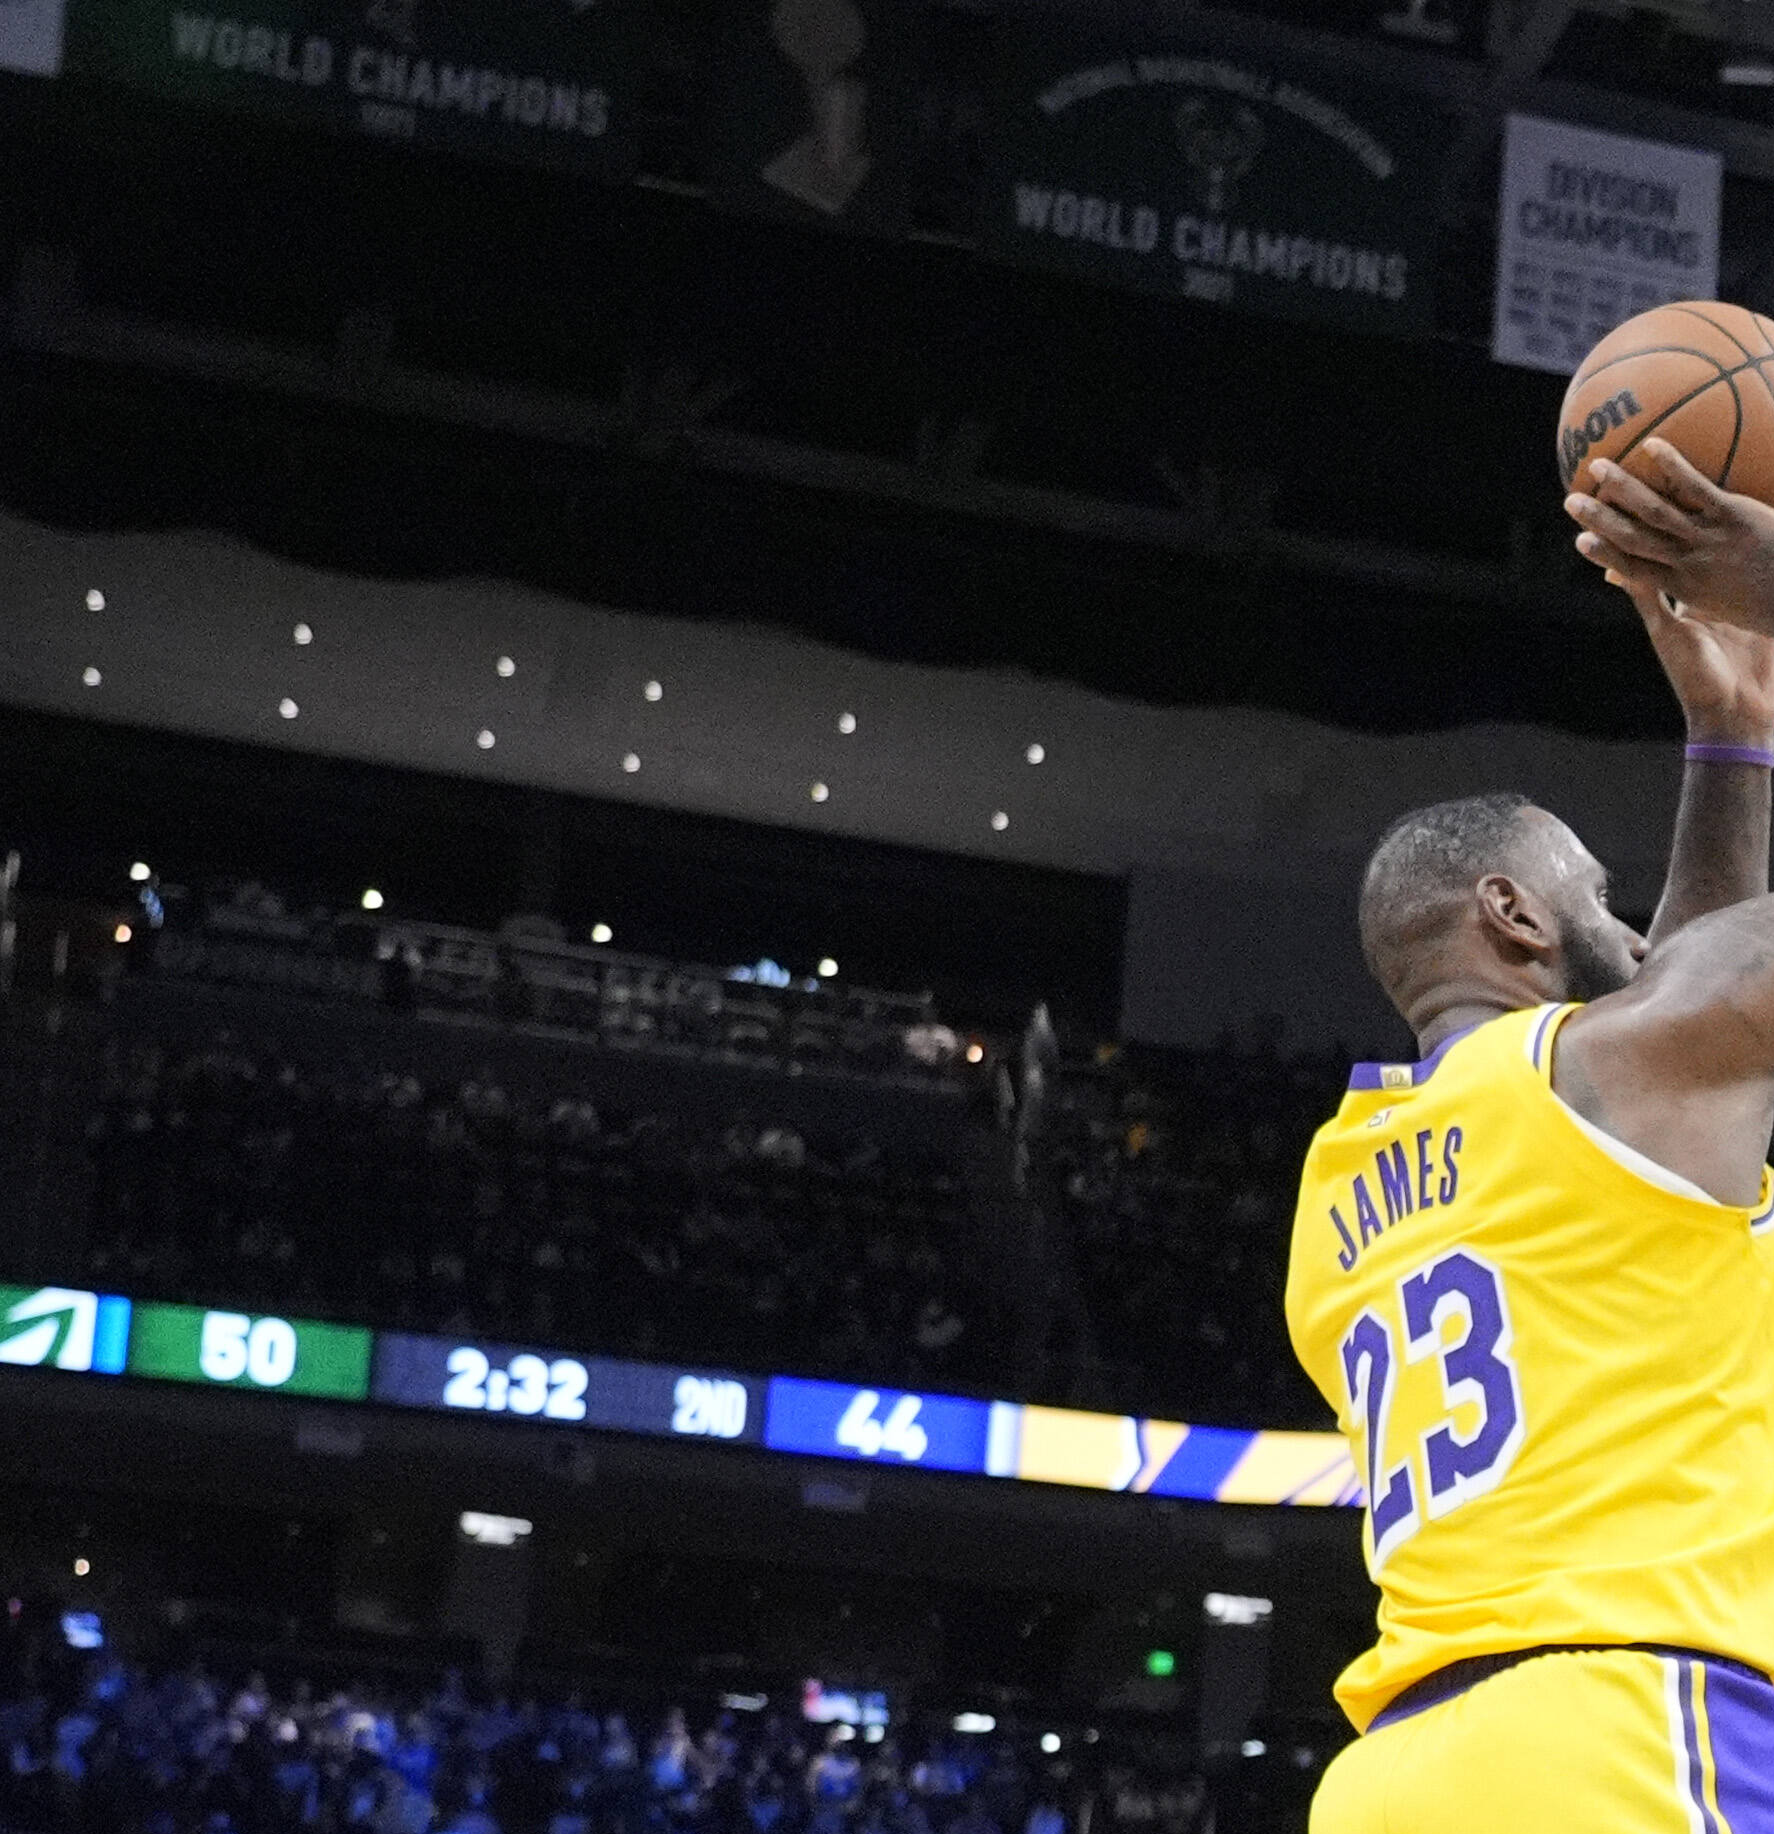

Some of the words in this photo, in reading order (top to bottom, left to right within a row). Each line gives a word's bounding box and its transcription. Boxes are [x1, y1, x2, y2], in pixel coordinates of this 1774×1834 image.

[171, 11, 333, 87] WORLD
[350, 47, 609, 135] CHAMPIONS
[1014, 184, 1159, 251] WORLD
[1173, 215, 1408, 301] CHAMPIONS
[1518, 199, 1700, 268] CHAMPIONS
[1546, 162, 1680, 220] DIVISION
[1329, 1126, 1462, 1272] JAMES
[200, 1309, 297, 1387] 50
[443, 1347, 588, 1421] 2:32
[671, 1374, 748, 1439] 2ND
[835, 1388, 928, 1462] 44
[1338, 1245, 1526, 1583] 23
